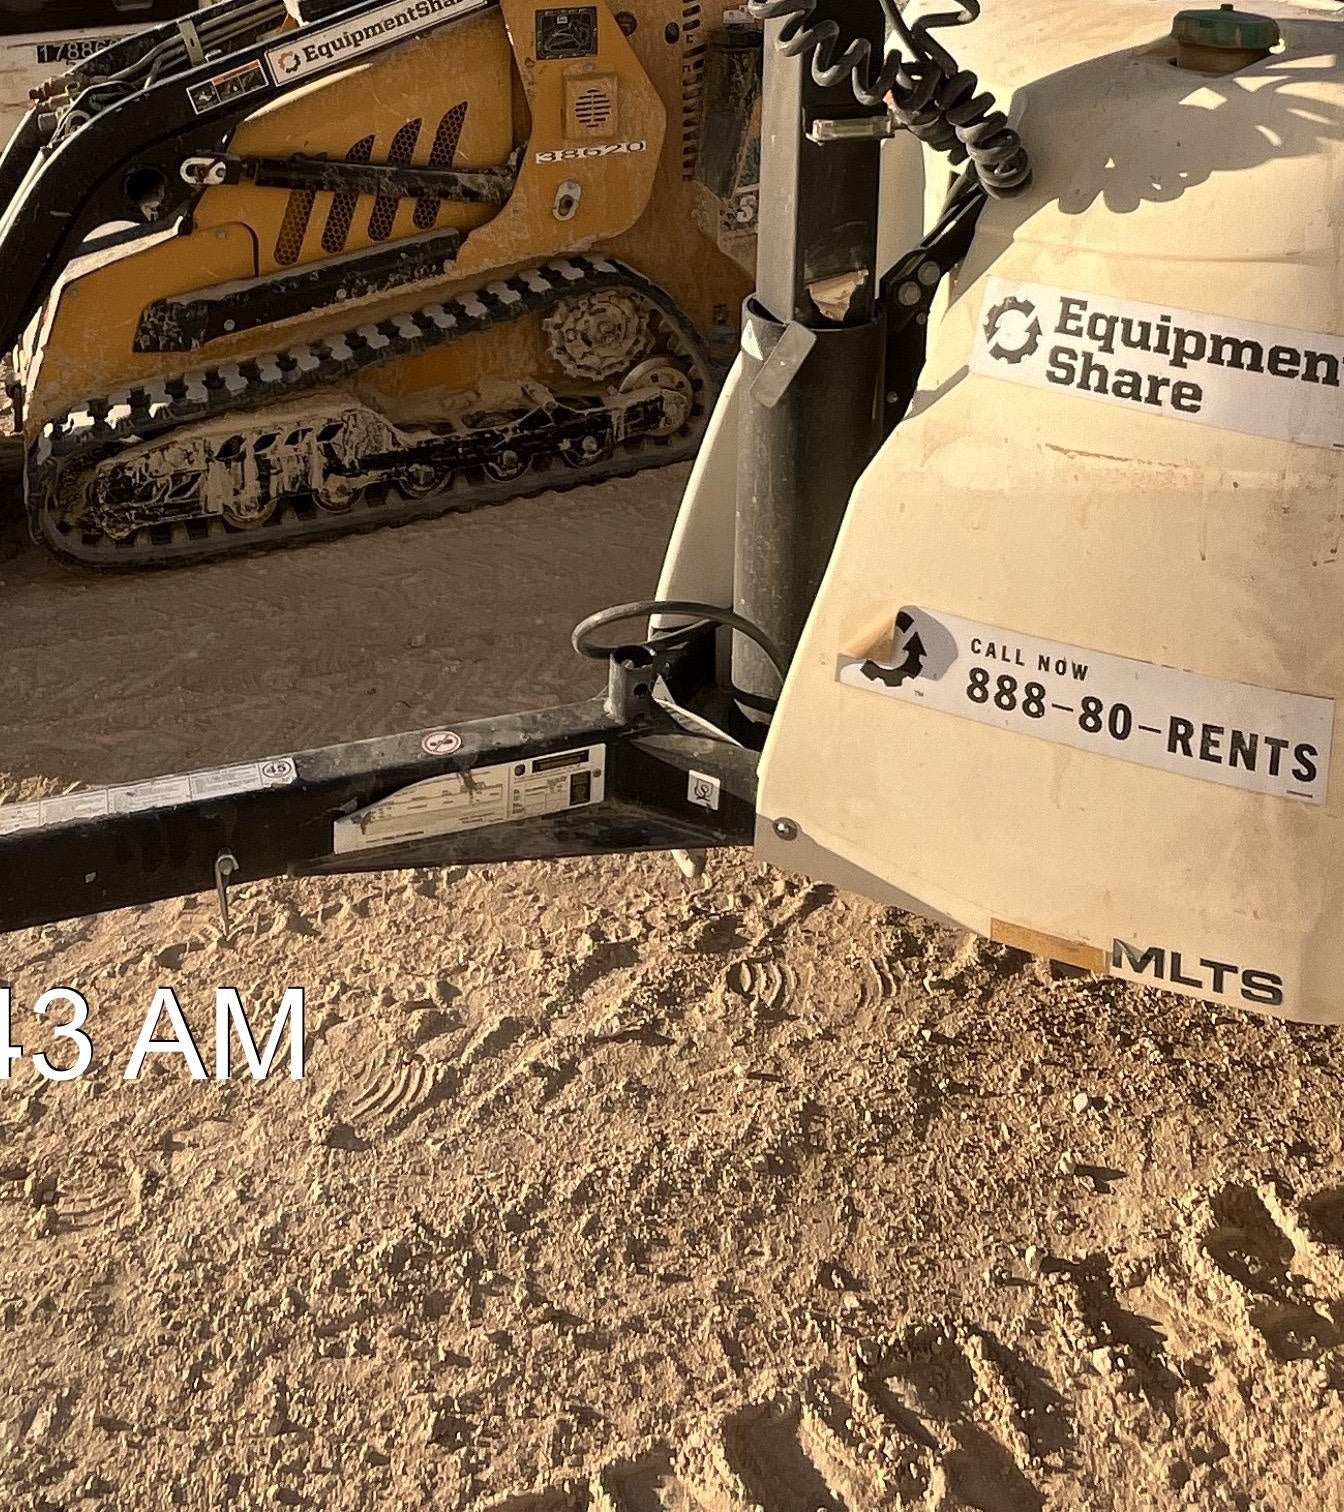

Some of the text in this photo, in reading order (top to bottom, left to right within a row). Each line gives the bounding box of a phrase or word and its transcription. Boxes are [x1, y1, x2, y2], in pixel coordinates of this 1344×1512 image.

[1046, 345, 1203, 414] Share
[971, 638, 1088, 681] CALL NOW
[966, 667, 1318, 783] 888-80-RENTS
[1112, 938, 1283, 1006] MLTS
